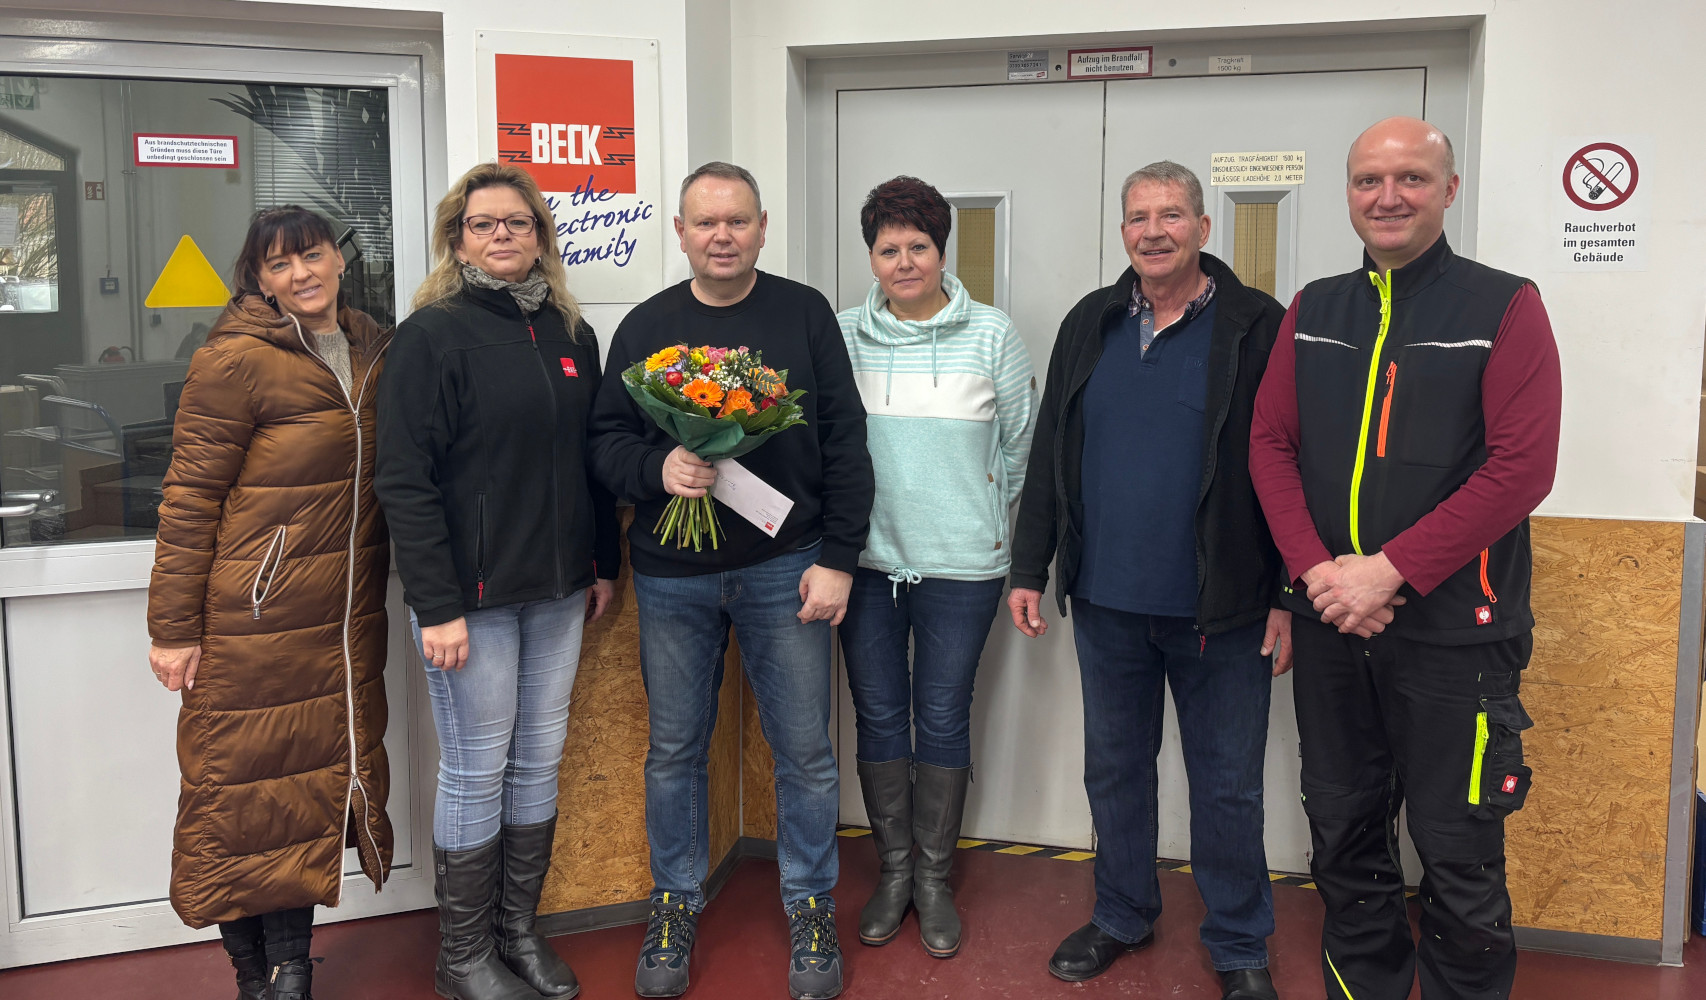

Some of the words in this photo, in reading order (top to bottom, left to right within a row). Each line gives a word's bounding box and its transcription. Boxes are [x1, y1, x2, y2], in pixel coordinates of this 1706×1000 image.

[1077, 55, 1100, 64] Aufzug
[1101, 54, 1110, 63] im
[1111, 52, 1143, 62] Brandfall
[1085, 65, 1103, 73] nicht
[1103, 64, 1134, 72] benutzen
[157, 139, 228, 147] brandschutztechnischen
[530, 122, 603, 166] BECK
[1239, 154, 1278, 163] TRAGFÄHIGKEIT
[1282, 154, 1294, 162] 1500
[1296, 154, 1303, 162] kg
[1212, 165, 1248, 173] EINSCHLIESSLICH
[1249, 164, 1284, 172] EINGEWIESENER
[1212, 174, 1241, 182] ZULÄSSIGE
[1243, 174, 1271, 182] LADEHÖHE
[543, 195, 560, 211] n
[570, 174, 618, 206] the
[553, 201, 653, 237] ectronic
[1564, 222, 1636, 233] Rauchverbot
[561, 228, 637, 267] family
[1563, 237, 1577, 248] im
[1580, 238, 1635, 250] gesamten
[1573, 252, 1624, 262] Gebäude
